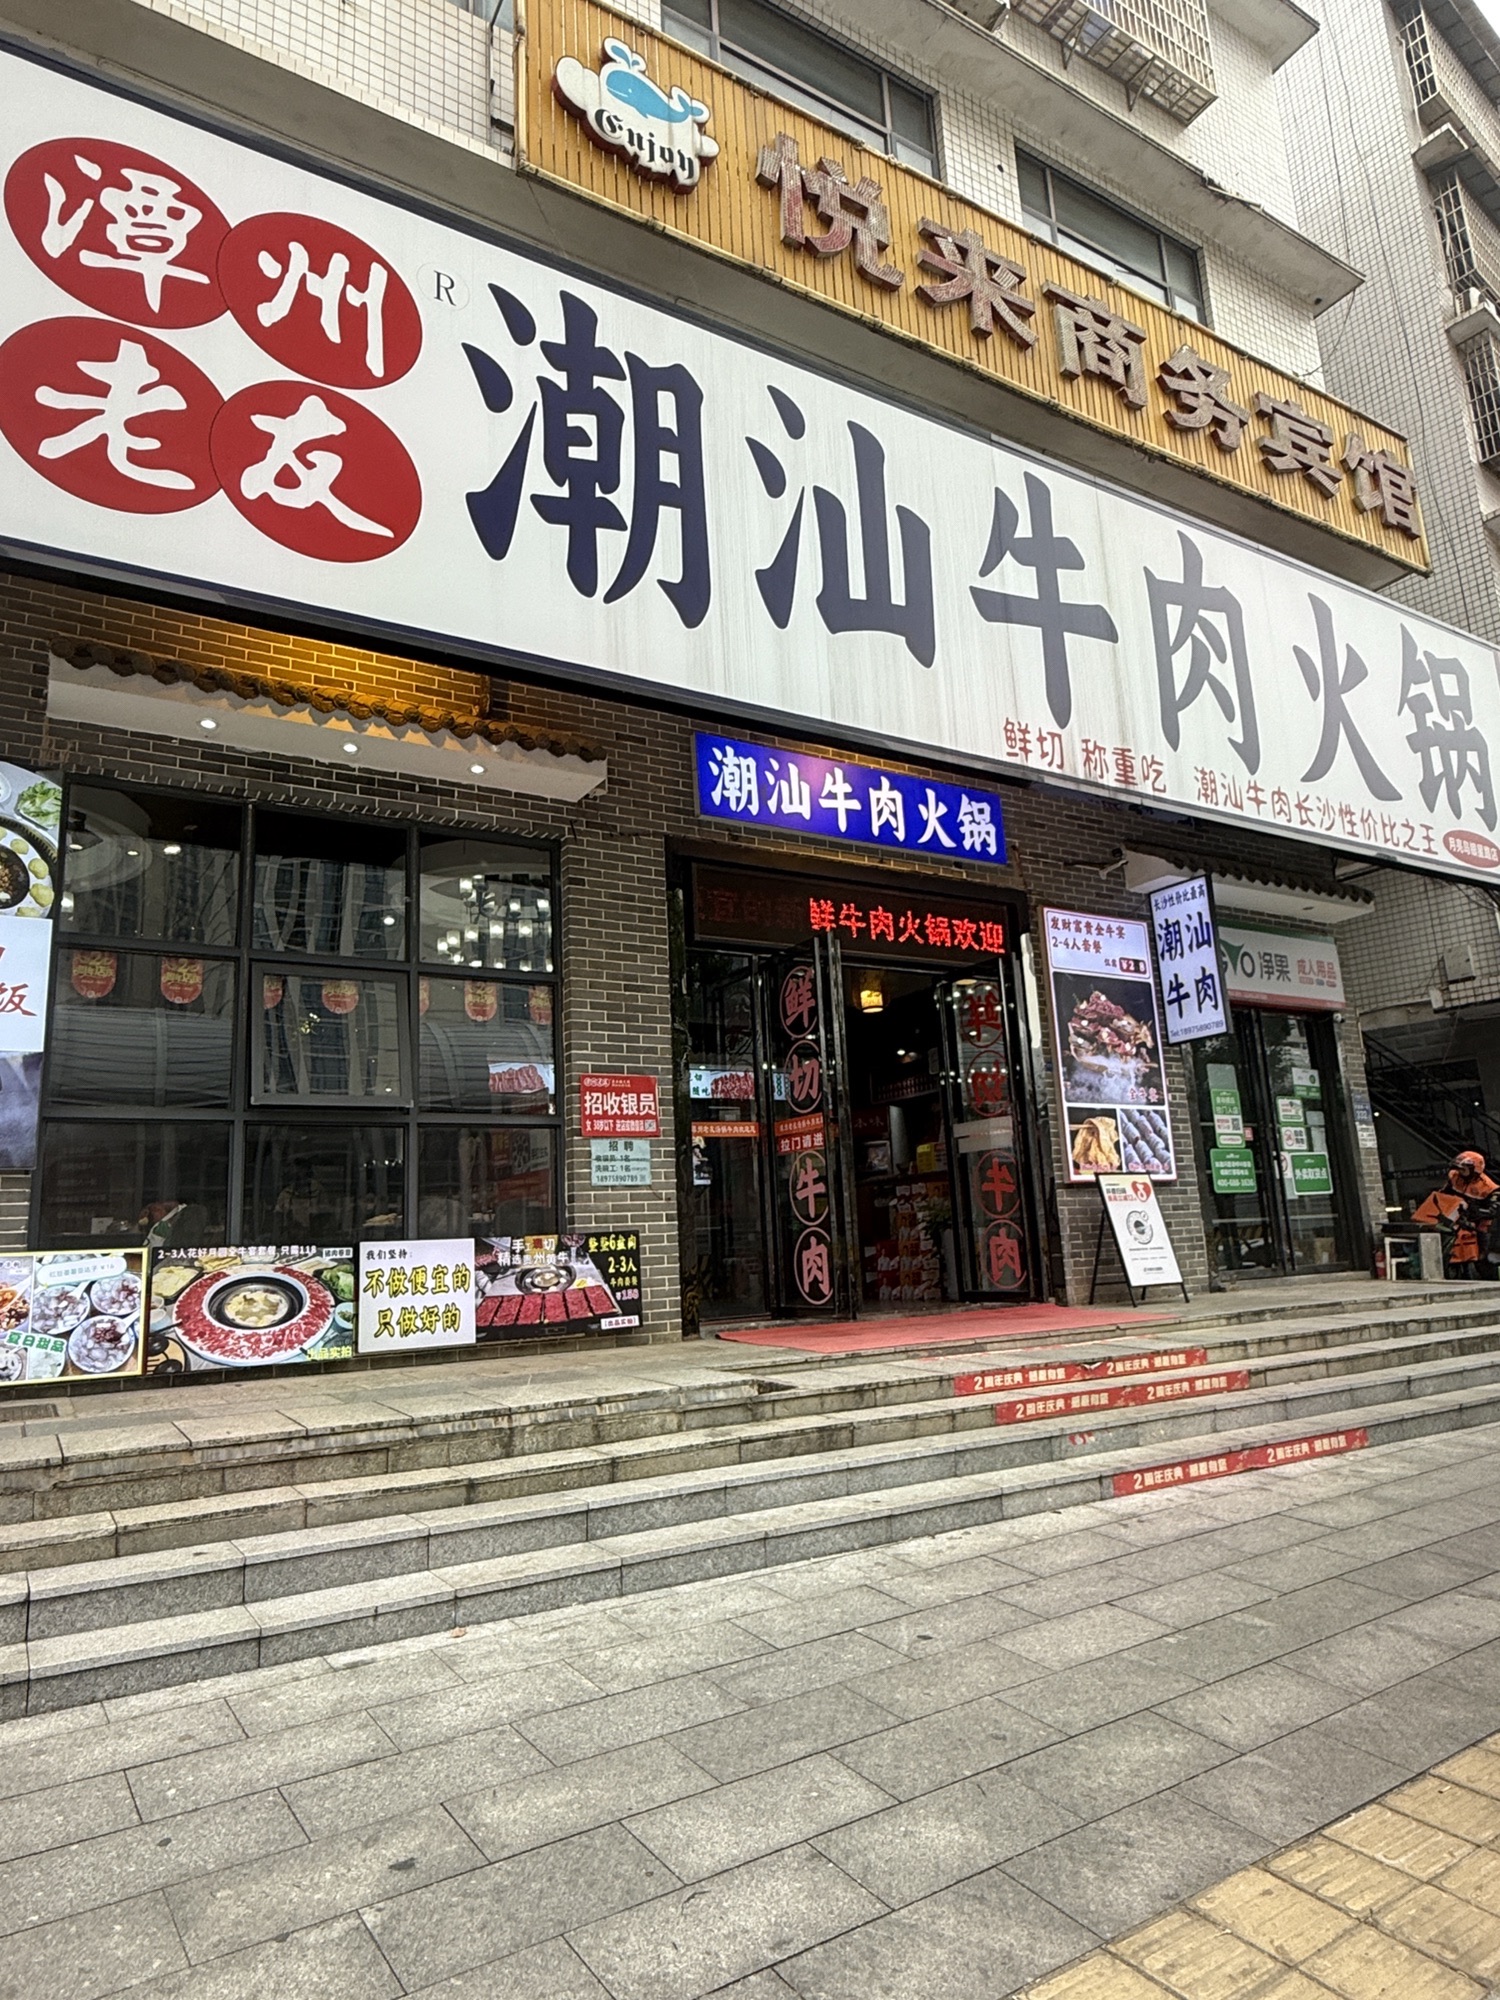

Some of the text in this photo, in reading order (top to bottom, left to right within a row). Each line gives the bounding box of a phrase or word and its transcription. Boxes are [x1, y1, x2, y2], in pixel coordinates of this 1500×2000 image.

[595, 109, 695, 180] Enjoy
[41, 155, 388, 378] 潭州
[755, 131, 1420, 540] 悦来商务宾馆
[35, 342, 394, 538] 老友
[461, 283, 1498, 832] 潮汕牛肉火锅
[708, 745, 997, 855] 潮汕牛肉火锅
[1003, 717, 1438, 855] 鲜切 称重吃 潮汕牛肉长沙性价比之王
[809, 897, 1005, 954] 鲜牛肉火锅欢迎
[1052, 936, 1102, 954] 2-4人套餐
[1158, 911, 1212, 962] 潮汕
[1166, 966, 1219, 1019] 牛肉
[584, 1092, 656, 1116] 招收银员
[781, 1133, 825, 1152] 拉门请进
[363, 1264, 471, 1298] 不做便宜的
[608, 1256, 637, 1273] 2-3人
[7, 1332, 66, 1352] 夏日甜品
[374, 1302, 462, 1338] 只做好的
